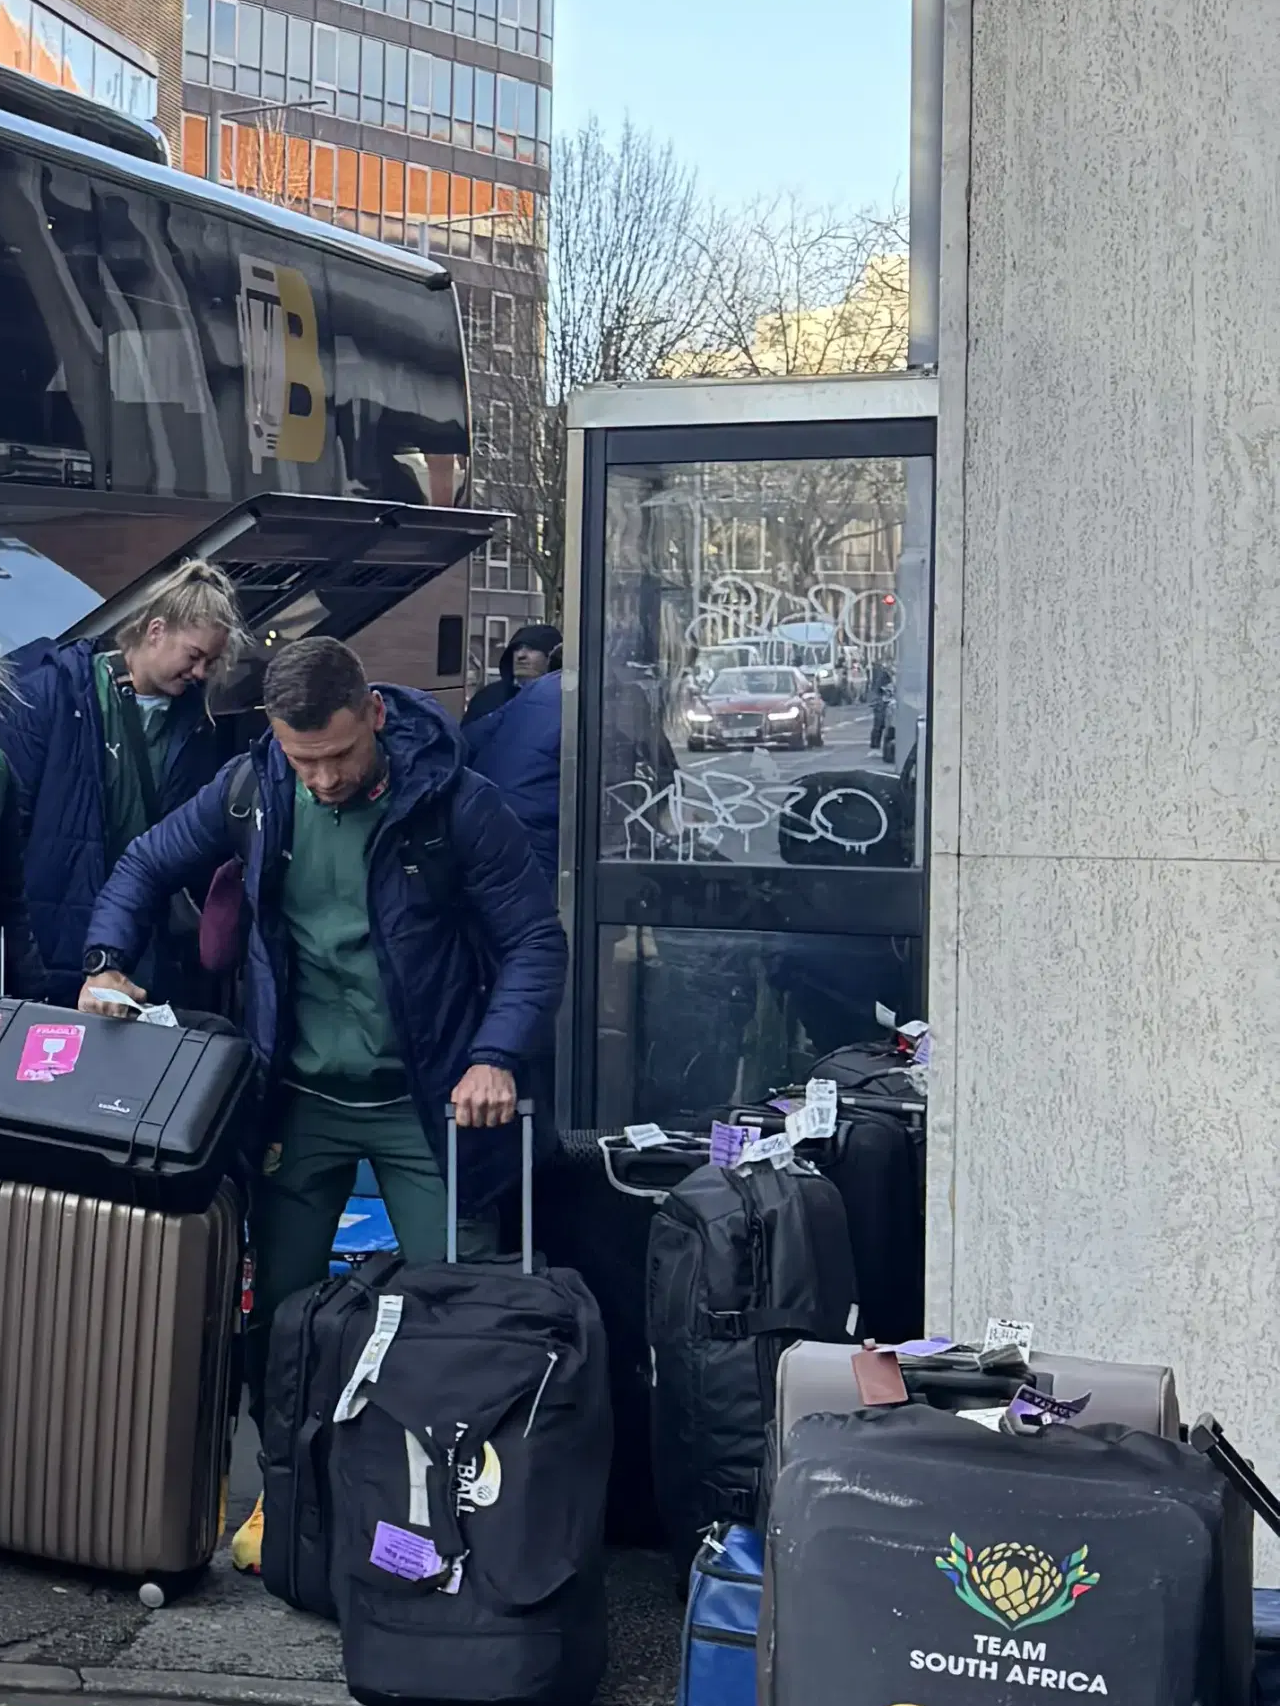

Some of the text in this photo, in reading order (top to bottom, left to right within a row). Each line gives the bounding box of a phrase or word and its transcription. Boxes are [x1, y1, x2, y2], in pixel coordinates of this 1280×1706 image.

[973, 1633, 1047, 1663] TEAM
[909, 1649, 1109, 1696] SOUTH AFRICA
